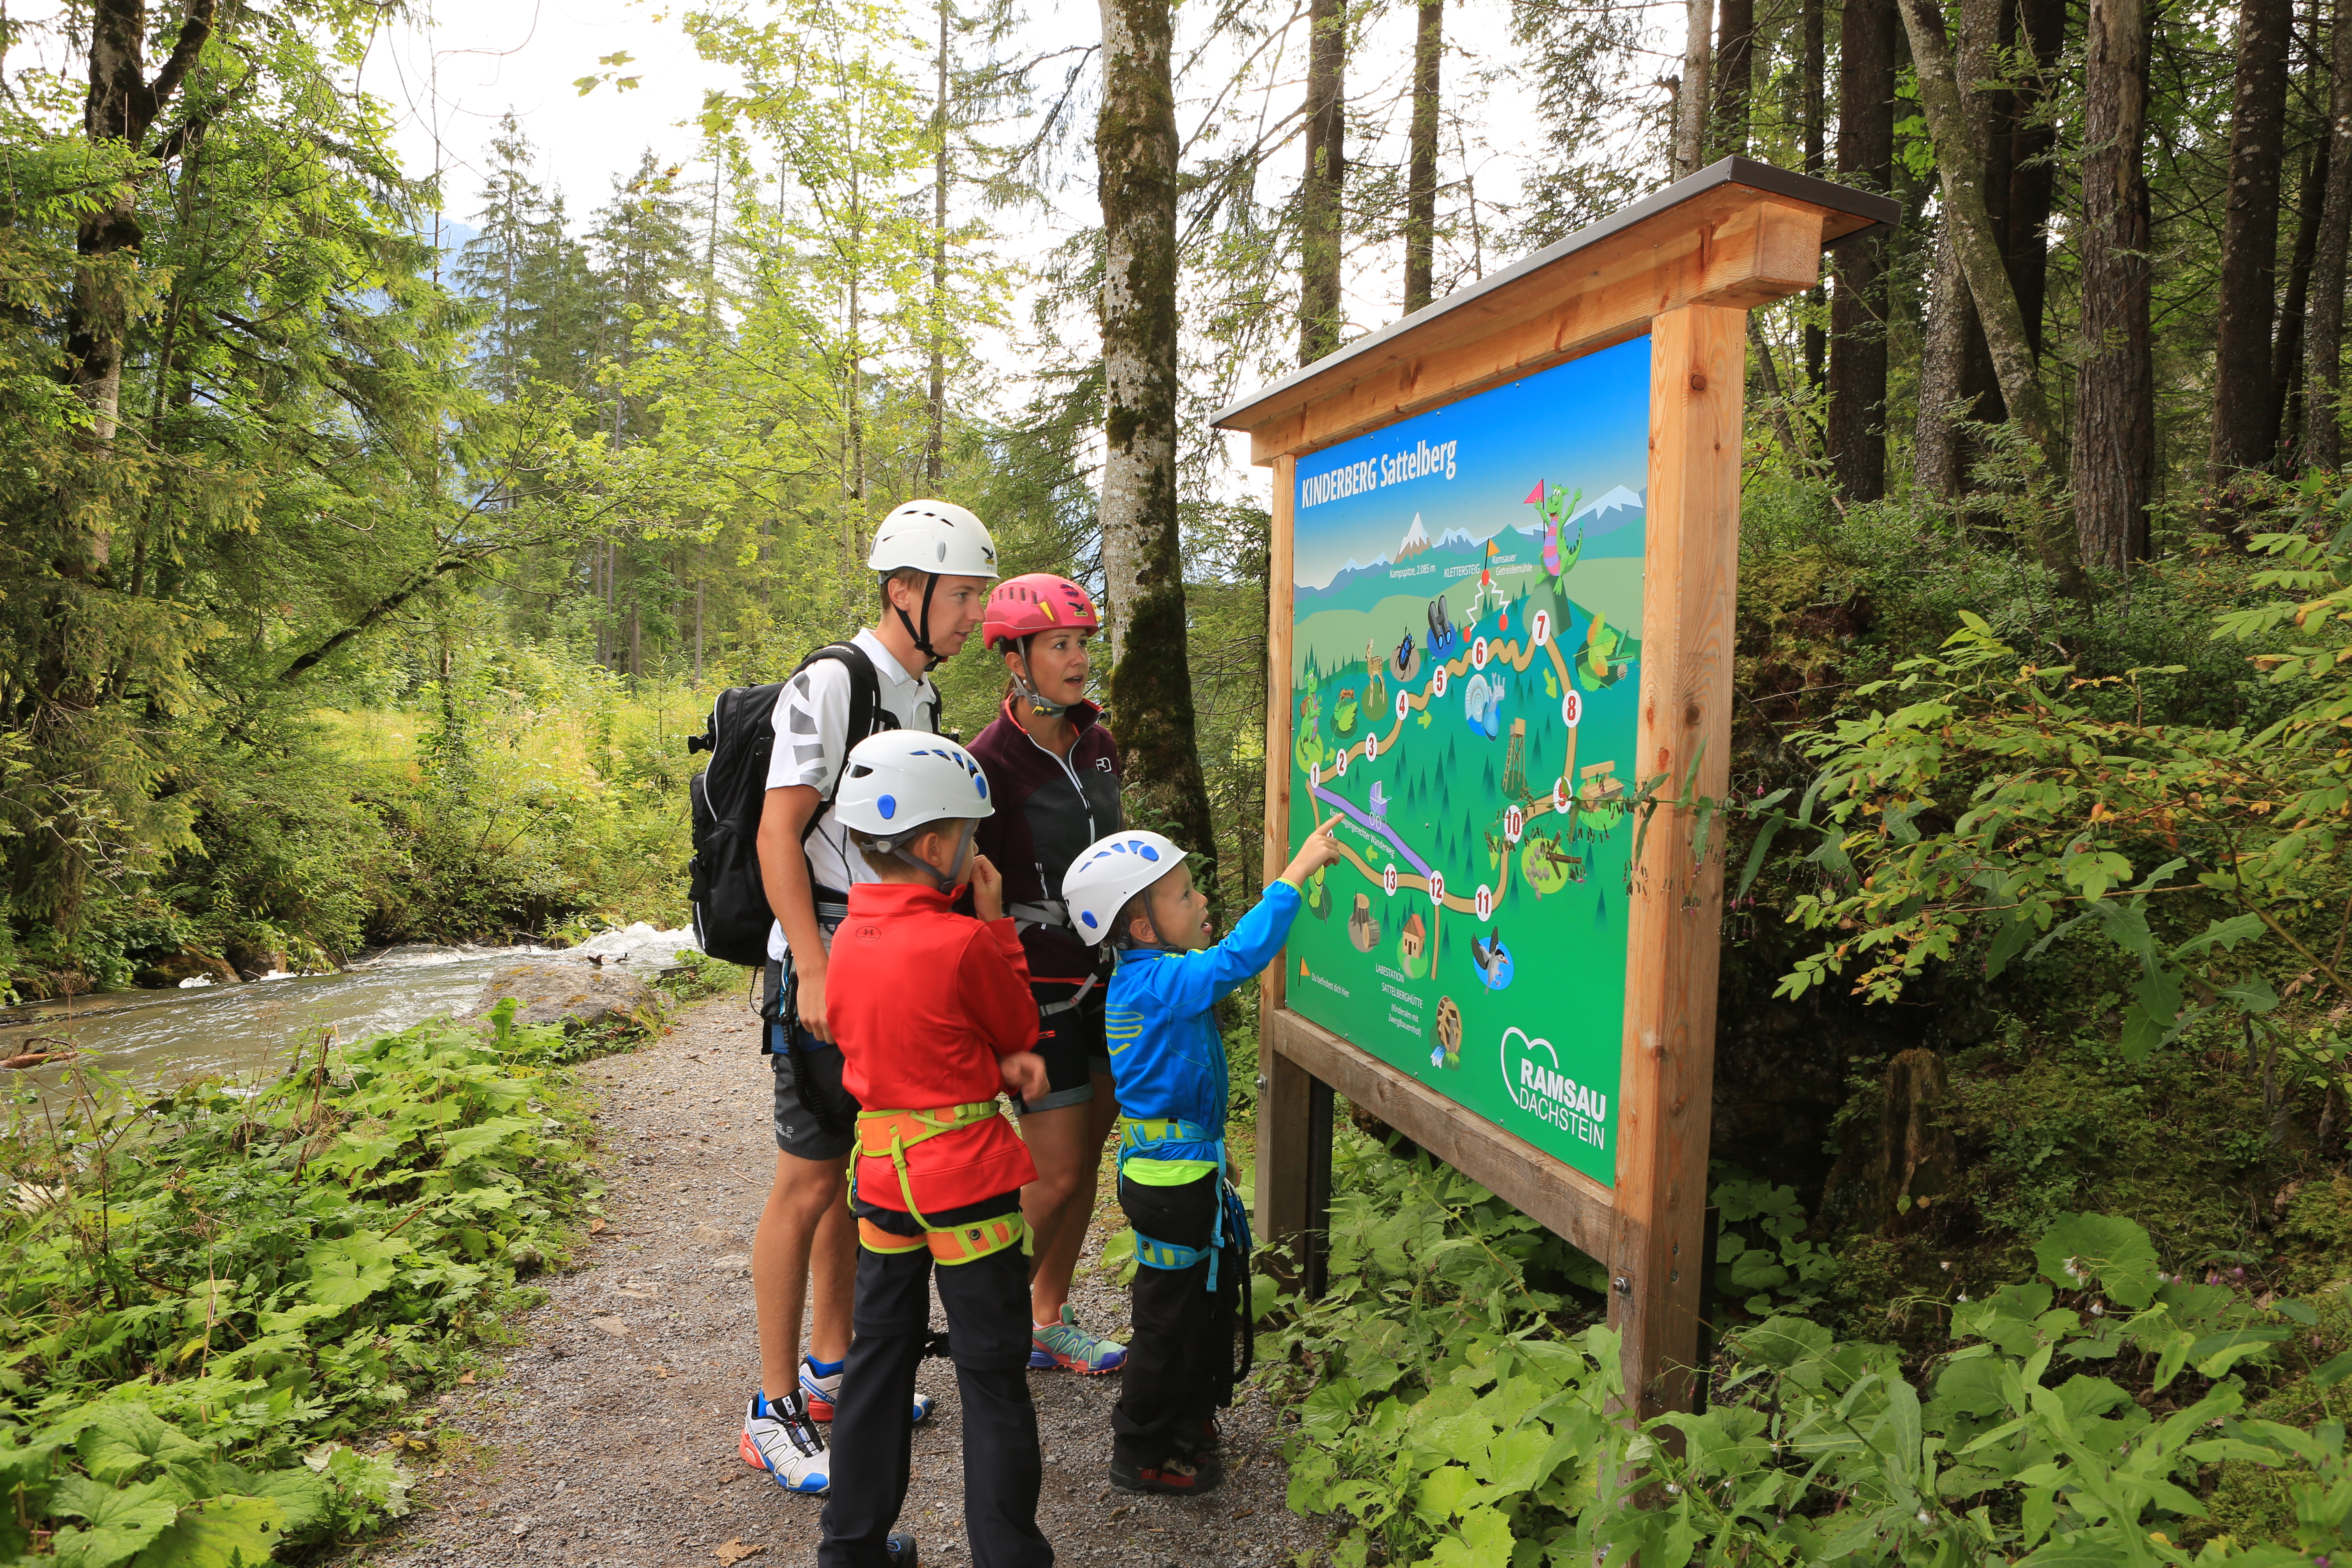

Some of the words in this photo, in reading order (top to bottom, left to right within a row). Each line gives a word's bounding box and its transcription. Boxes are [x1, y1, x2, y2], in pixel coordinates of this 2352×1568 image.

[1302, 457, 1377, 509] KINDERBERG
[1380, 439, 1457, 487] Sattelberg
[1492, 554, 1517, 564] Ramsauer
[1496, 563, 1532, 576] Getreidemühle
[1390, 568, 1415, 580] Kampspitze,
[1417, 564, 1430, 575] 2.085
[1444, 564, 1480, 578] KLETTERSTEIG
[1537, 615, 1546, 639] 7
[1476, 641, 1483, 664] 6
[1437, 670, 1443, 692] 5
[1399, 695, 1405, 715] 4
[1567, 695, 1577, 721] 8
[1368, 737, 1374, 757] 3
[1339, 753, 1344, 771] 2
[1313, 765, 1317, 784] 1
[1506, 813, 1520, 835] 10
[1370, 834, 1395, 860] Wanderweg
[1385, 869, 1396, 890] 13
[1431, 877, 1443, 899] 12
[1477, 891, 1489, 914] 11
[1312, 972, 1317, 982] Du
[1317, 975, 1334, 991] befindest
[1376, 963, 1404, 983] LABESTATION
[1381, 982, 1423, 1009] SATTELBERGHÜTTE
[1391, 1003, 1411, 1020] (Kinderalm
[1521, 1057, 1606, 1123] RAMSAU
[1519, 1087, 1605, 1151] DACHSTEIN
